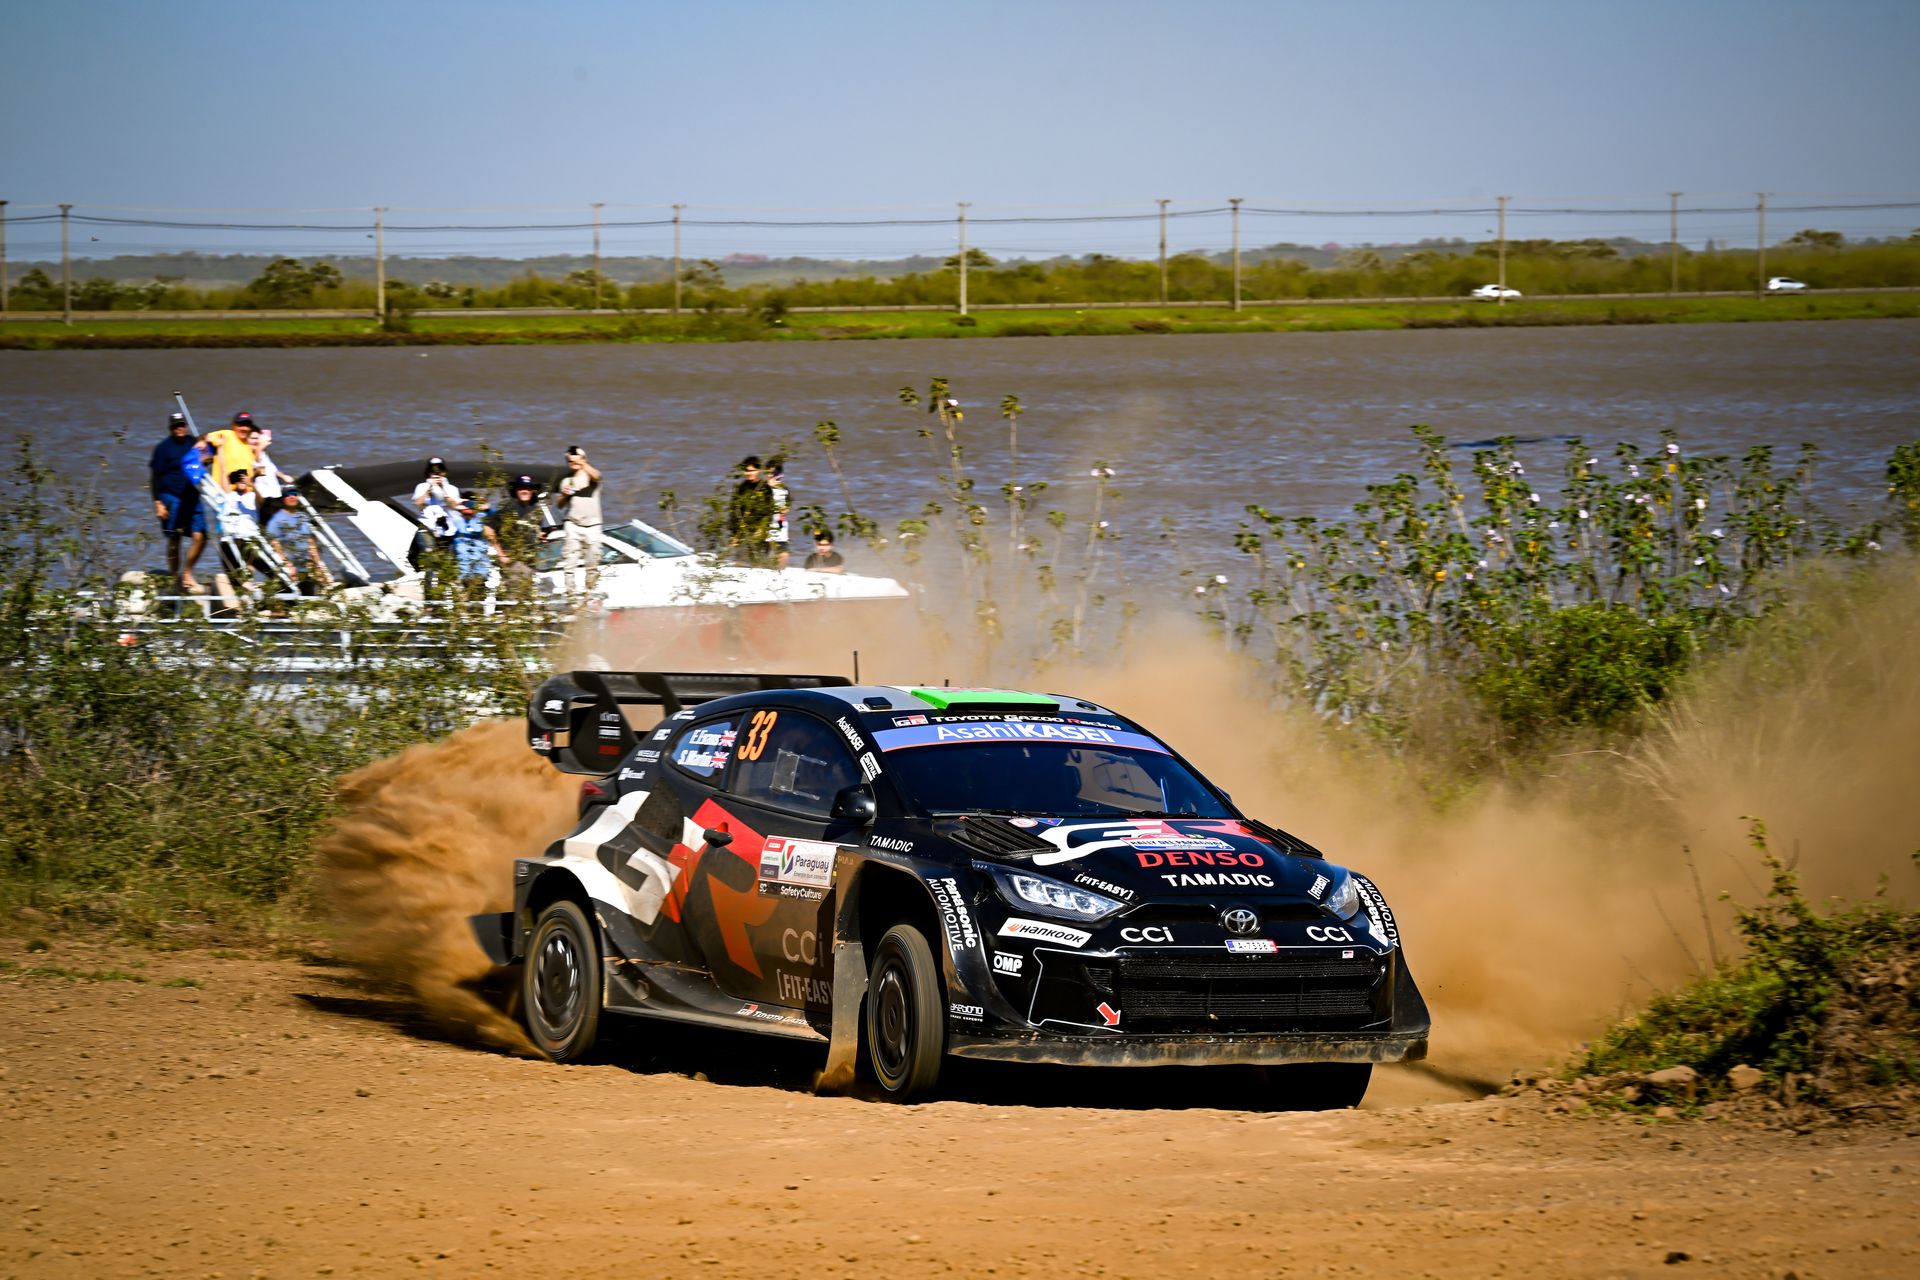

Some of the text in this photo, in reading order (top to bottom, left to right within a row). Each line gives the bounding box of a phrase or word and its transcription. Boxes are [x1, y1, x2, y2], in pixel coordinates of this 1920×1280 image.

[931, 714, 1000, 722] TOYOTA
[738, 711, 777, 760] 33
[937, 722, 1116, 743] AsahiKASEI
[870, 835, 914, 852] TAMADIC
[795, 855, 830, 873] Paraguay
[1136, 851, 1264, 868] DENSO
[1161, 873, 1274, 887] TAMADIC
[925, 878, 964, 951] AUTOMOTIVE
[941, 877, 976, 948] Panasonic
[993, 953, 1023, 974] OMP
